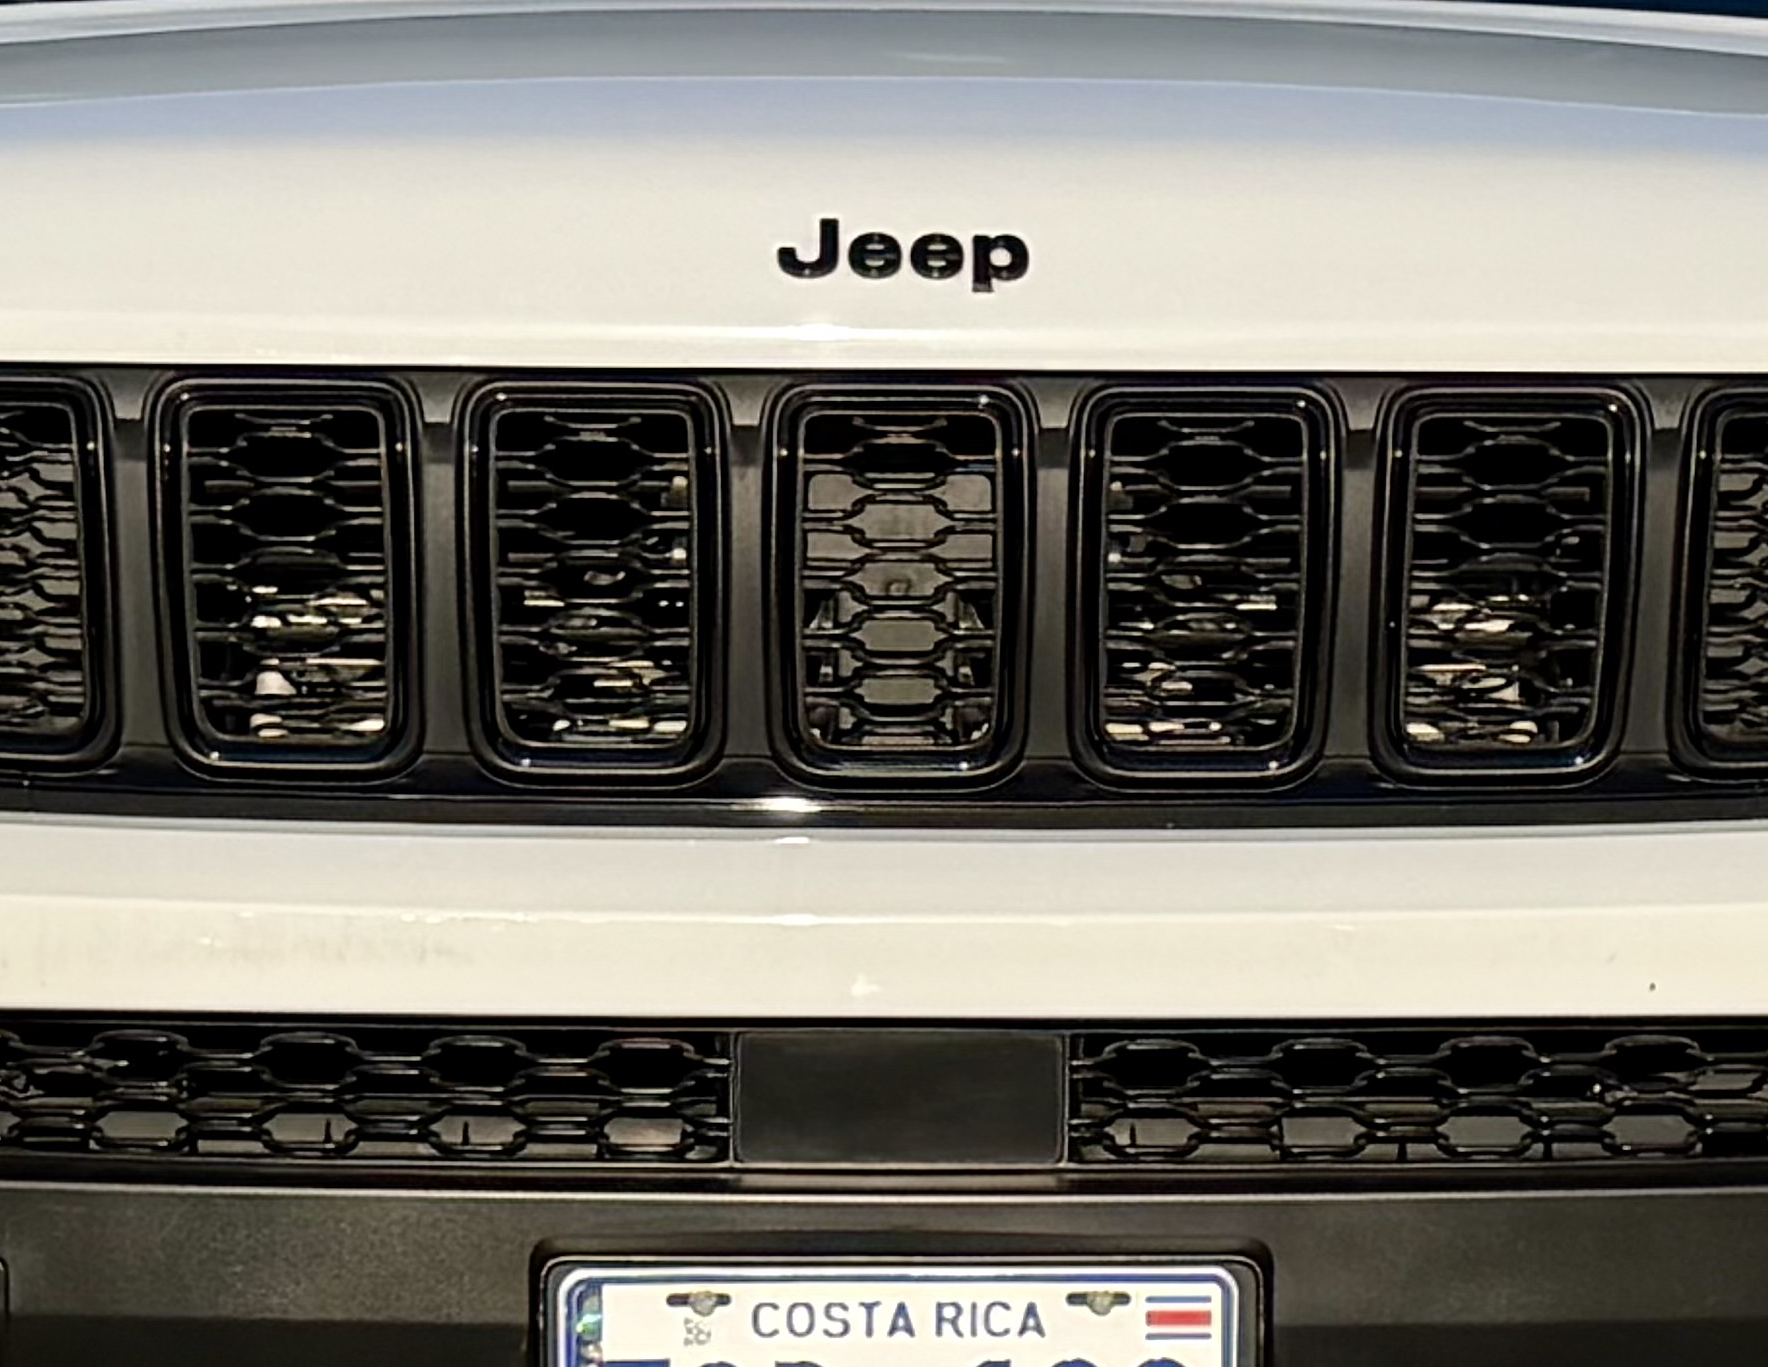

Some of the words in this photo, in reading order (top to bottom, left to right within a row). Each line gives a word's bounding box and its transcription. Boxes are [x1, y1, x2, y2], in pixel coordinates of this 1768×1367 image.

[777, 218, 1030, 293] Jeep
[751, 1301, 916, 1339] COSTA
[935, 1301, 1046, 1338] RICA
